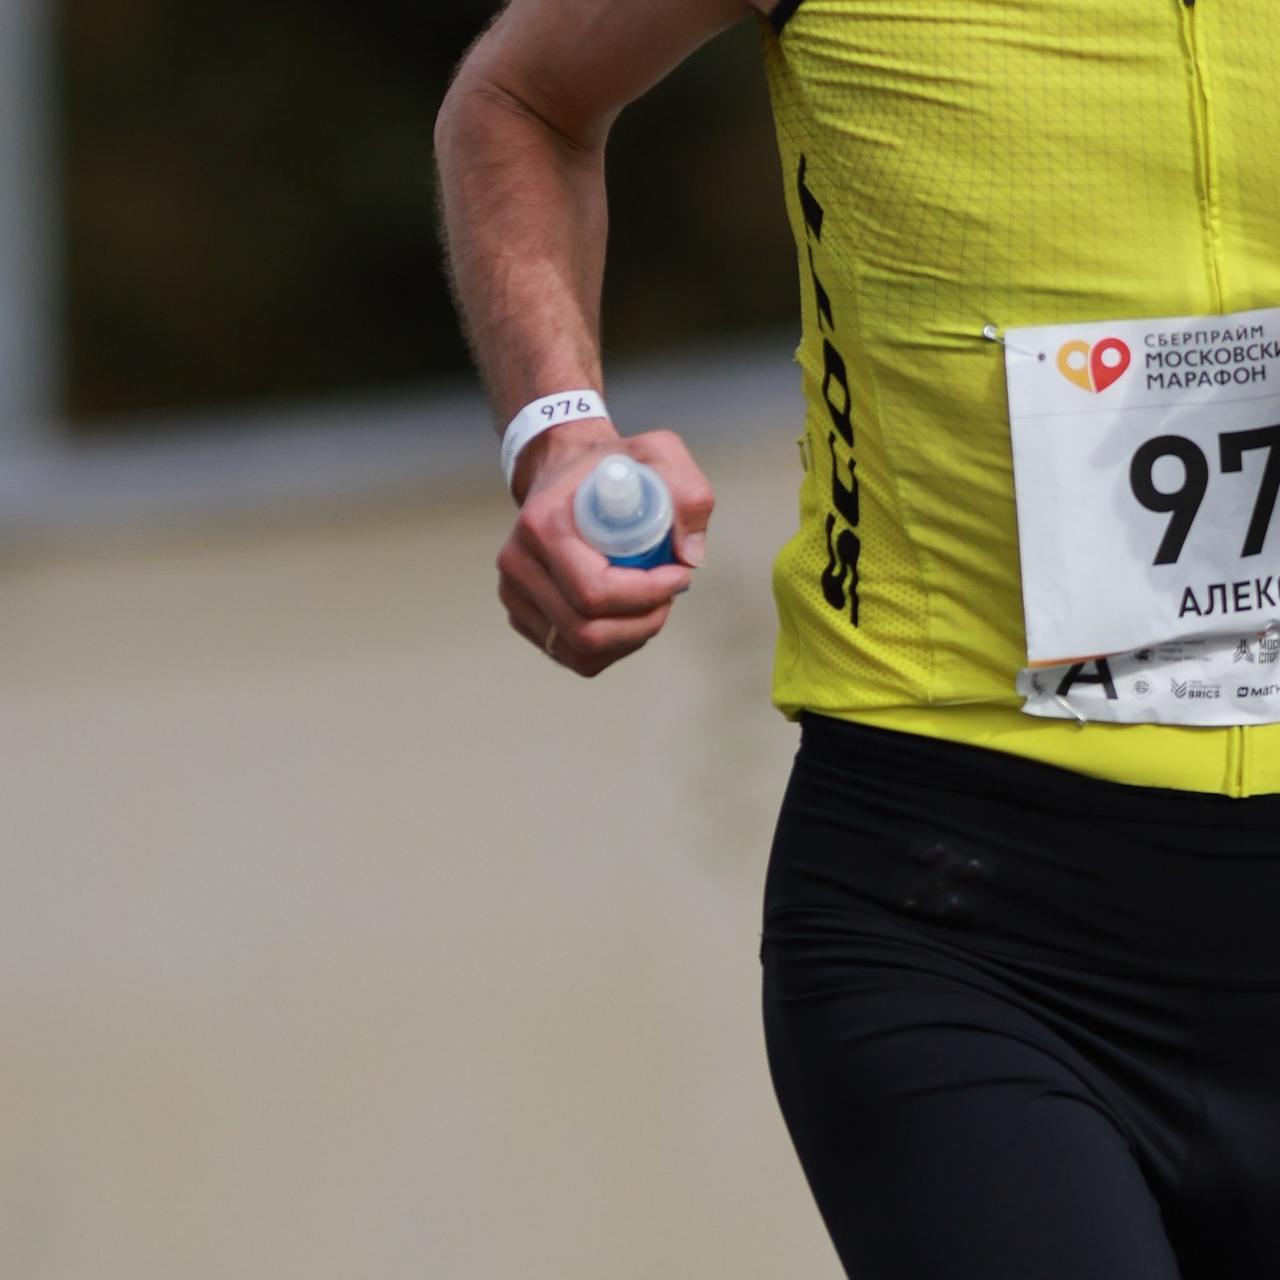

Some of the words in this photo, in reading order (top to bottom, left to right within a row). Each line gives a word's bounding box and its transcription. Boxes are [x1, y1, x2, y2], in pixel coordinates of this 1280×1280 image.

[1144, 324, 1264, 348] СБЕРПРАЙМ
[1147, 365, 1266, 390] МАРАФОН
[540, 397, 591, 420] 976
